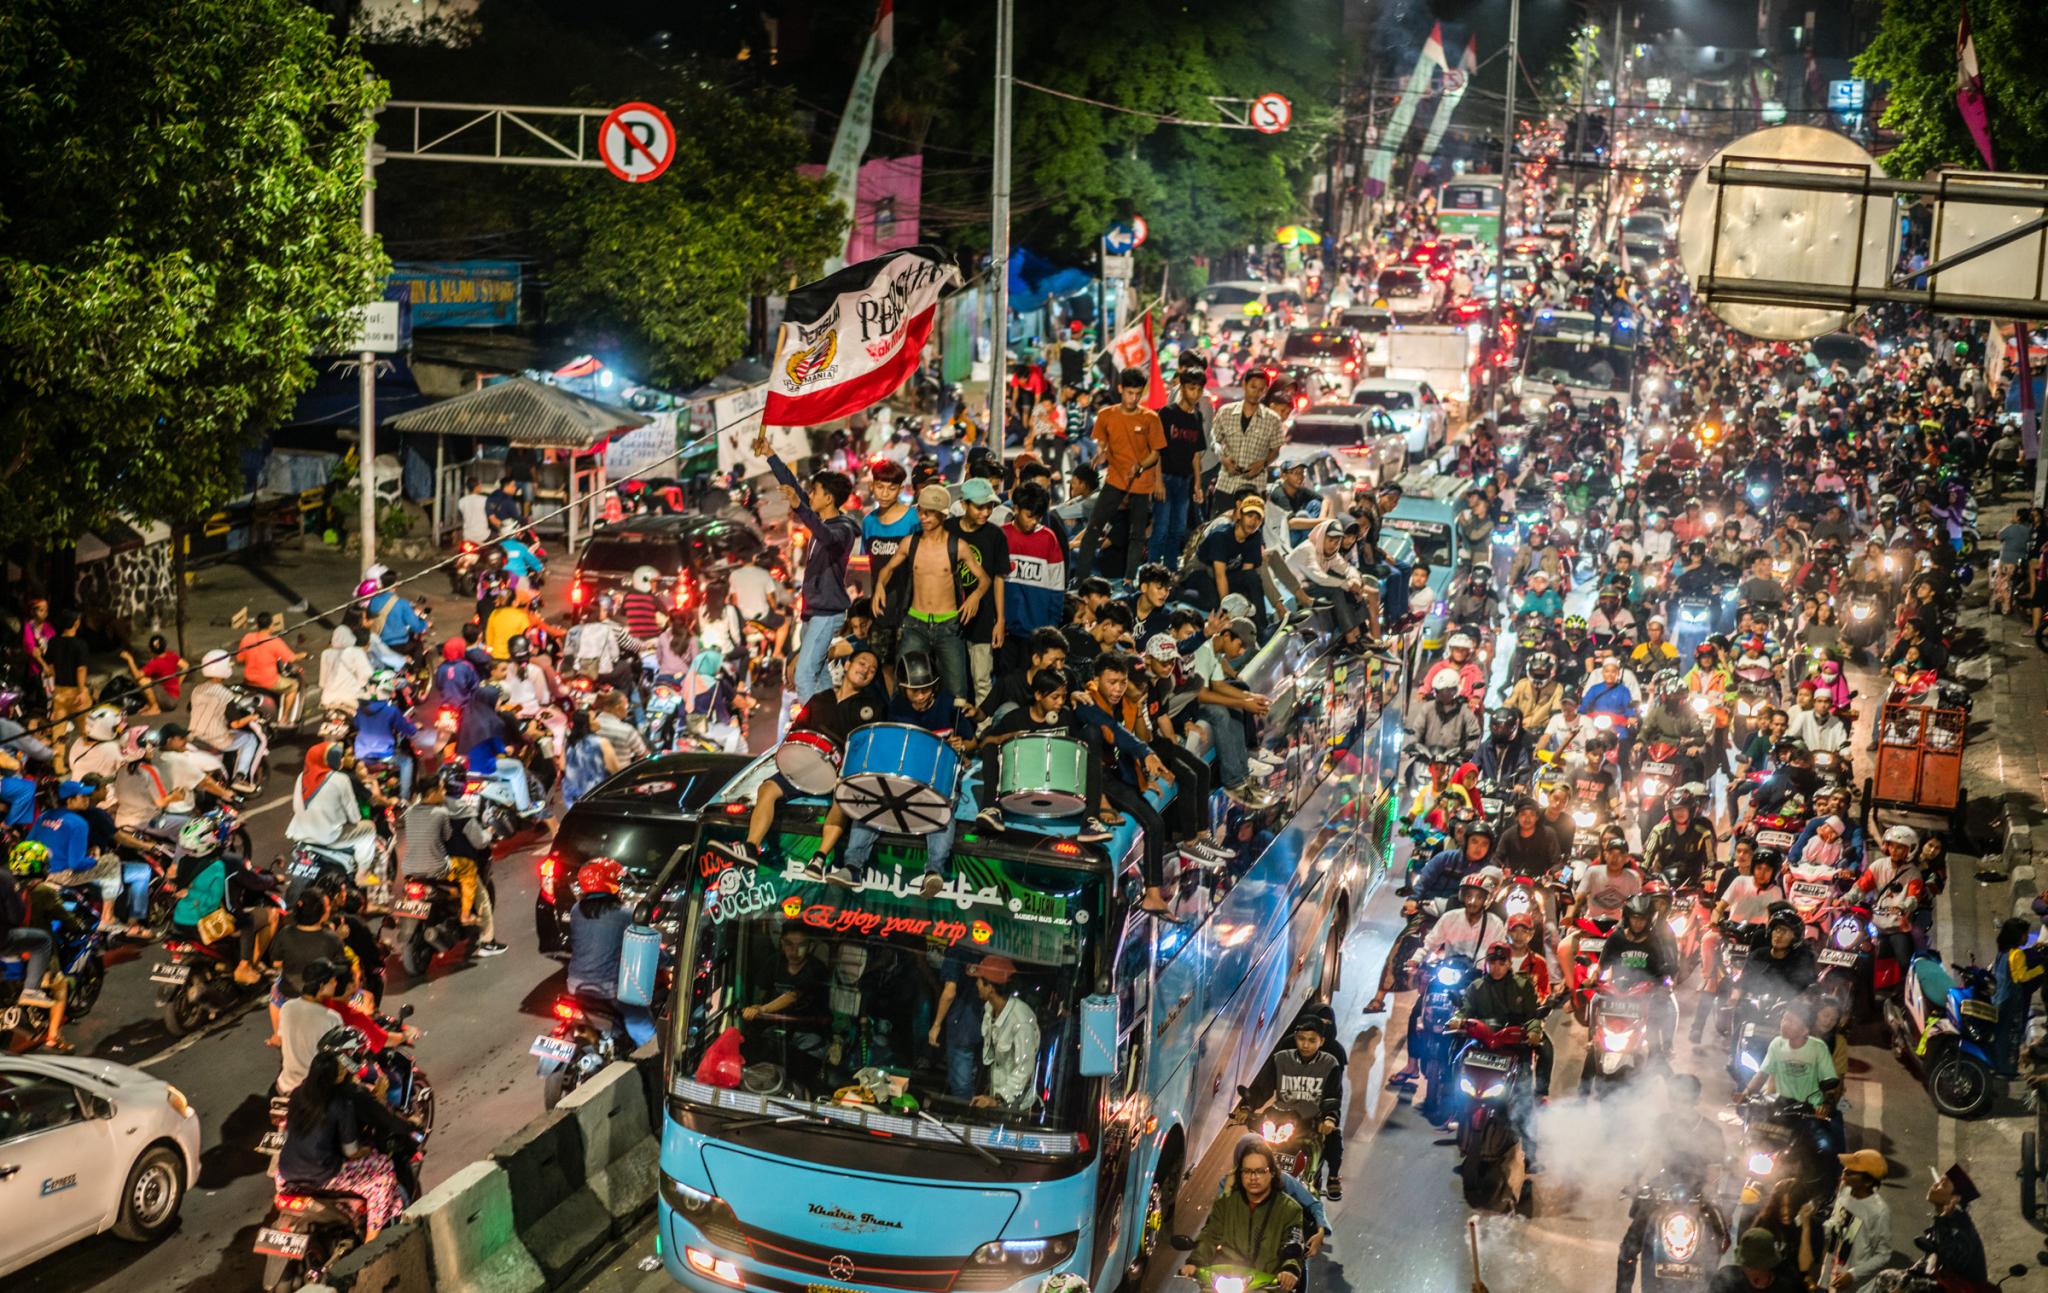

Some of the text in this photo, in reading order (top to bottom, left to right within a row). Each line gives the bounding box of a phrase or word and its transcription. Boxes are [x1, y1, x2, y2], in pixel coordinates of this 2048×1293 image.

[623, 121, 655, 166] P
[802, 904, 967, 947] Enjoy your trip
[860, 1212, 904, 1229] Trans
